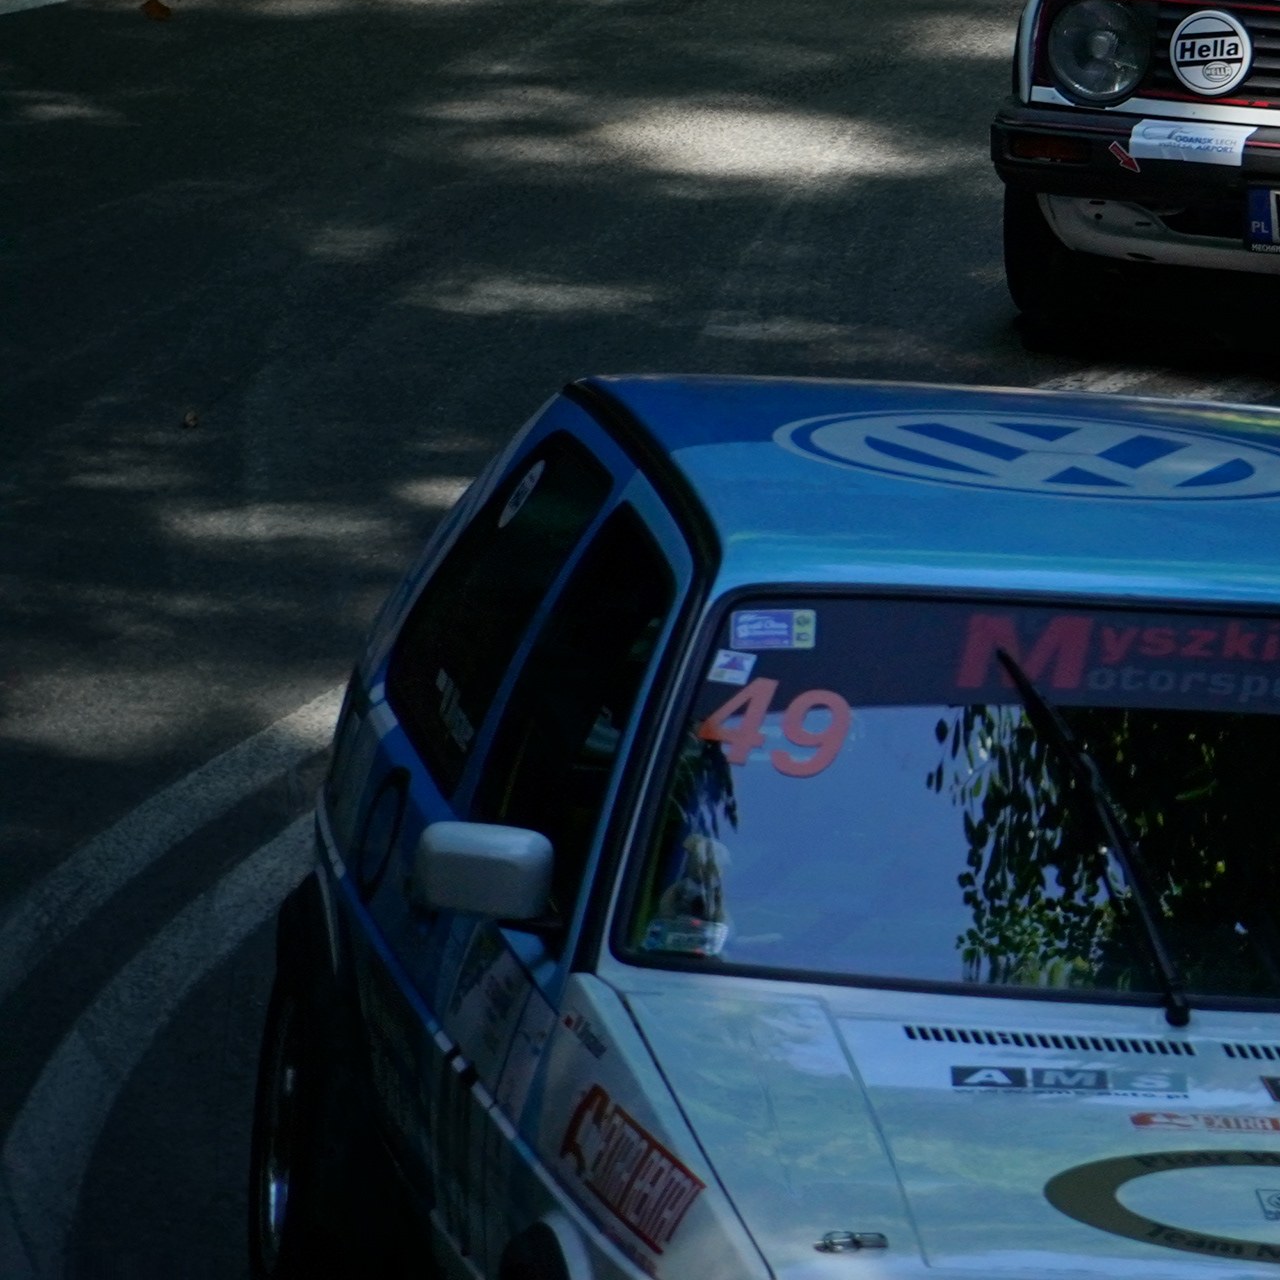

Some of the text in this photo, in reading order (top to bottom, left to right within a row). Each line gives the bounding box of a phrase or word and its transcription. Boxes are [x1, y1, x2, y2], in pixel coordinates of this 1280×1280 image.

[1180, 39, 1239, 60] Hella
[1251, 221, 1269, 234] PL
[697, 676, 853, 780] 49
[1147, 1222, 1245, 1256] Team
